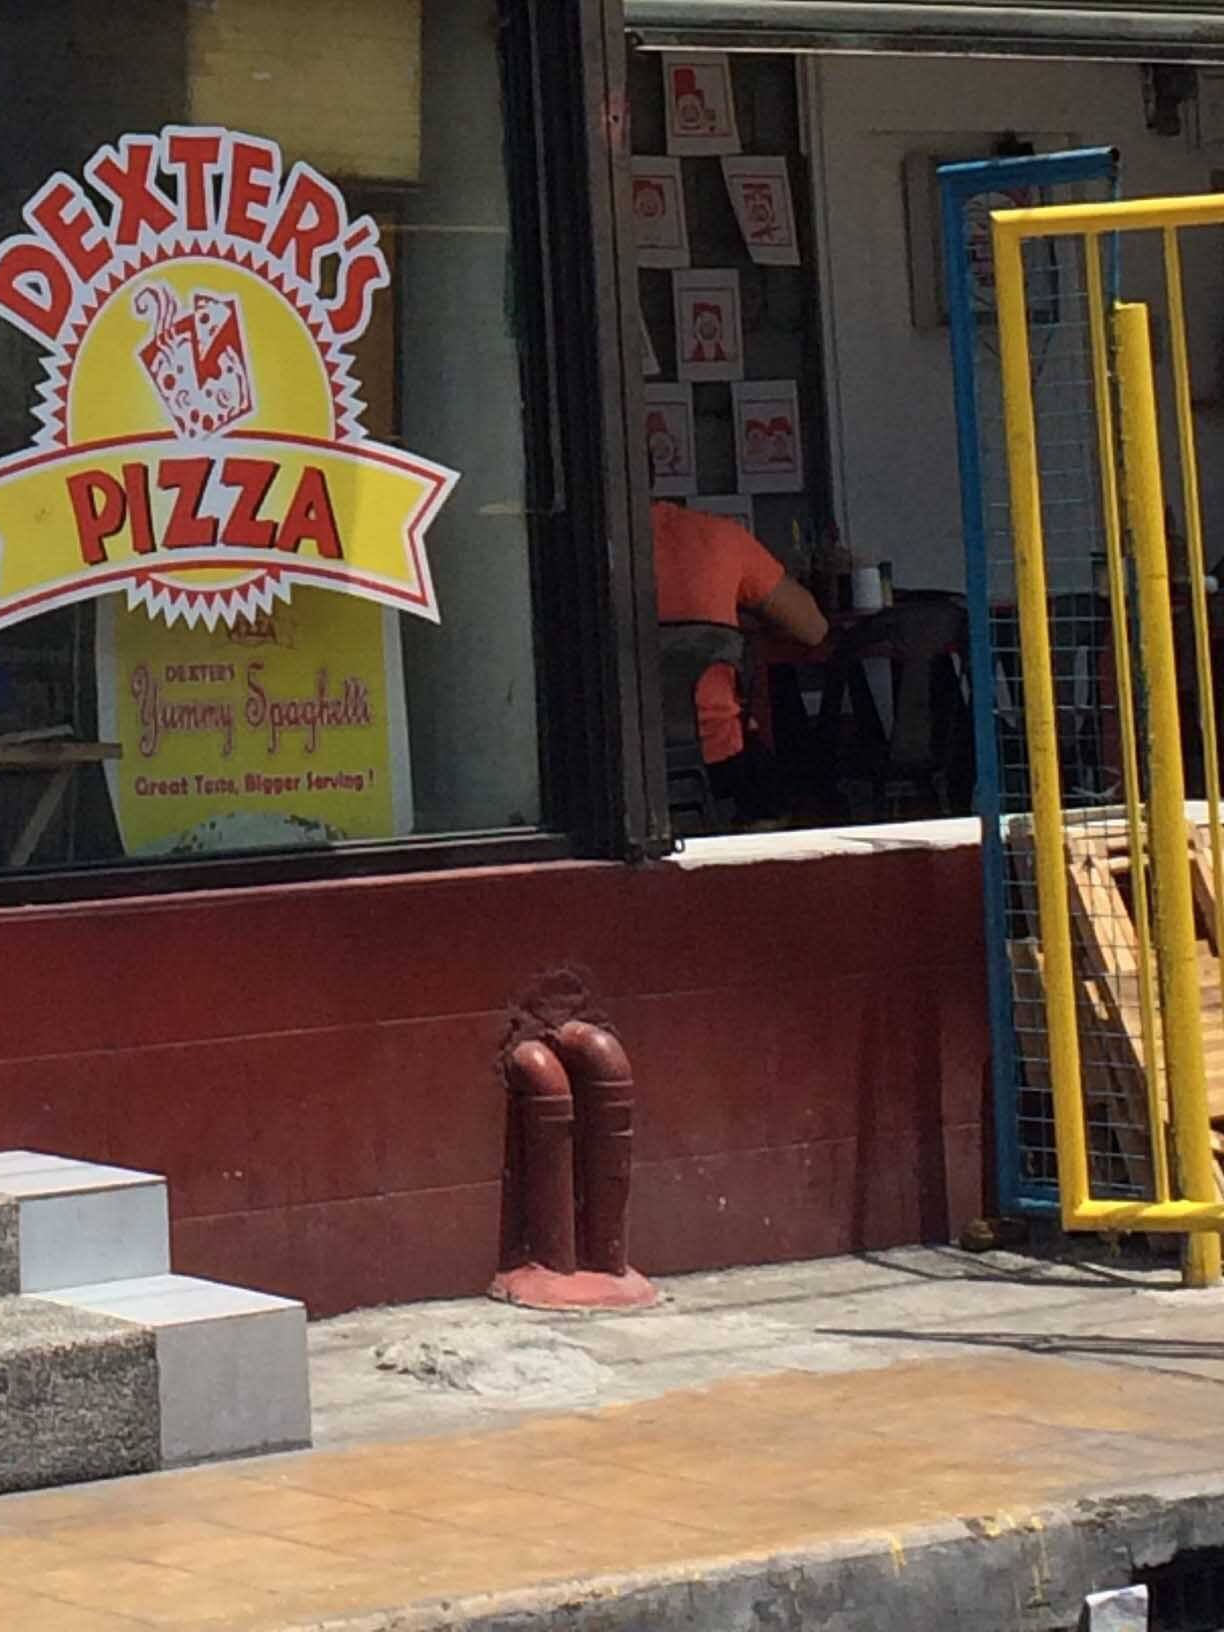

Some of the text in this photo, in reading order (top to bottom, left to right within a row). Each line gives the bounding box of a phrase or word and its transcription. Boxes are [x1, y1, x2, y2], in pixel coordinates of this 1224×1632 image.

[65, 456, 345, 567] PIZZA
[130, 661, 371, 758] Yummy Spaghetti
[135, 774, 189, 796] Great
[244, 771, 302, 795] Bigger
